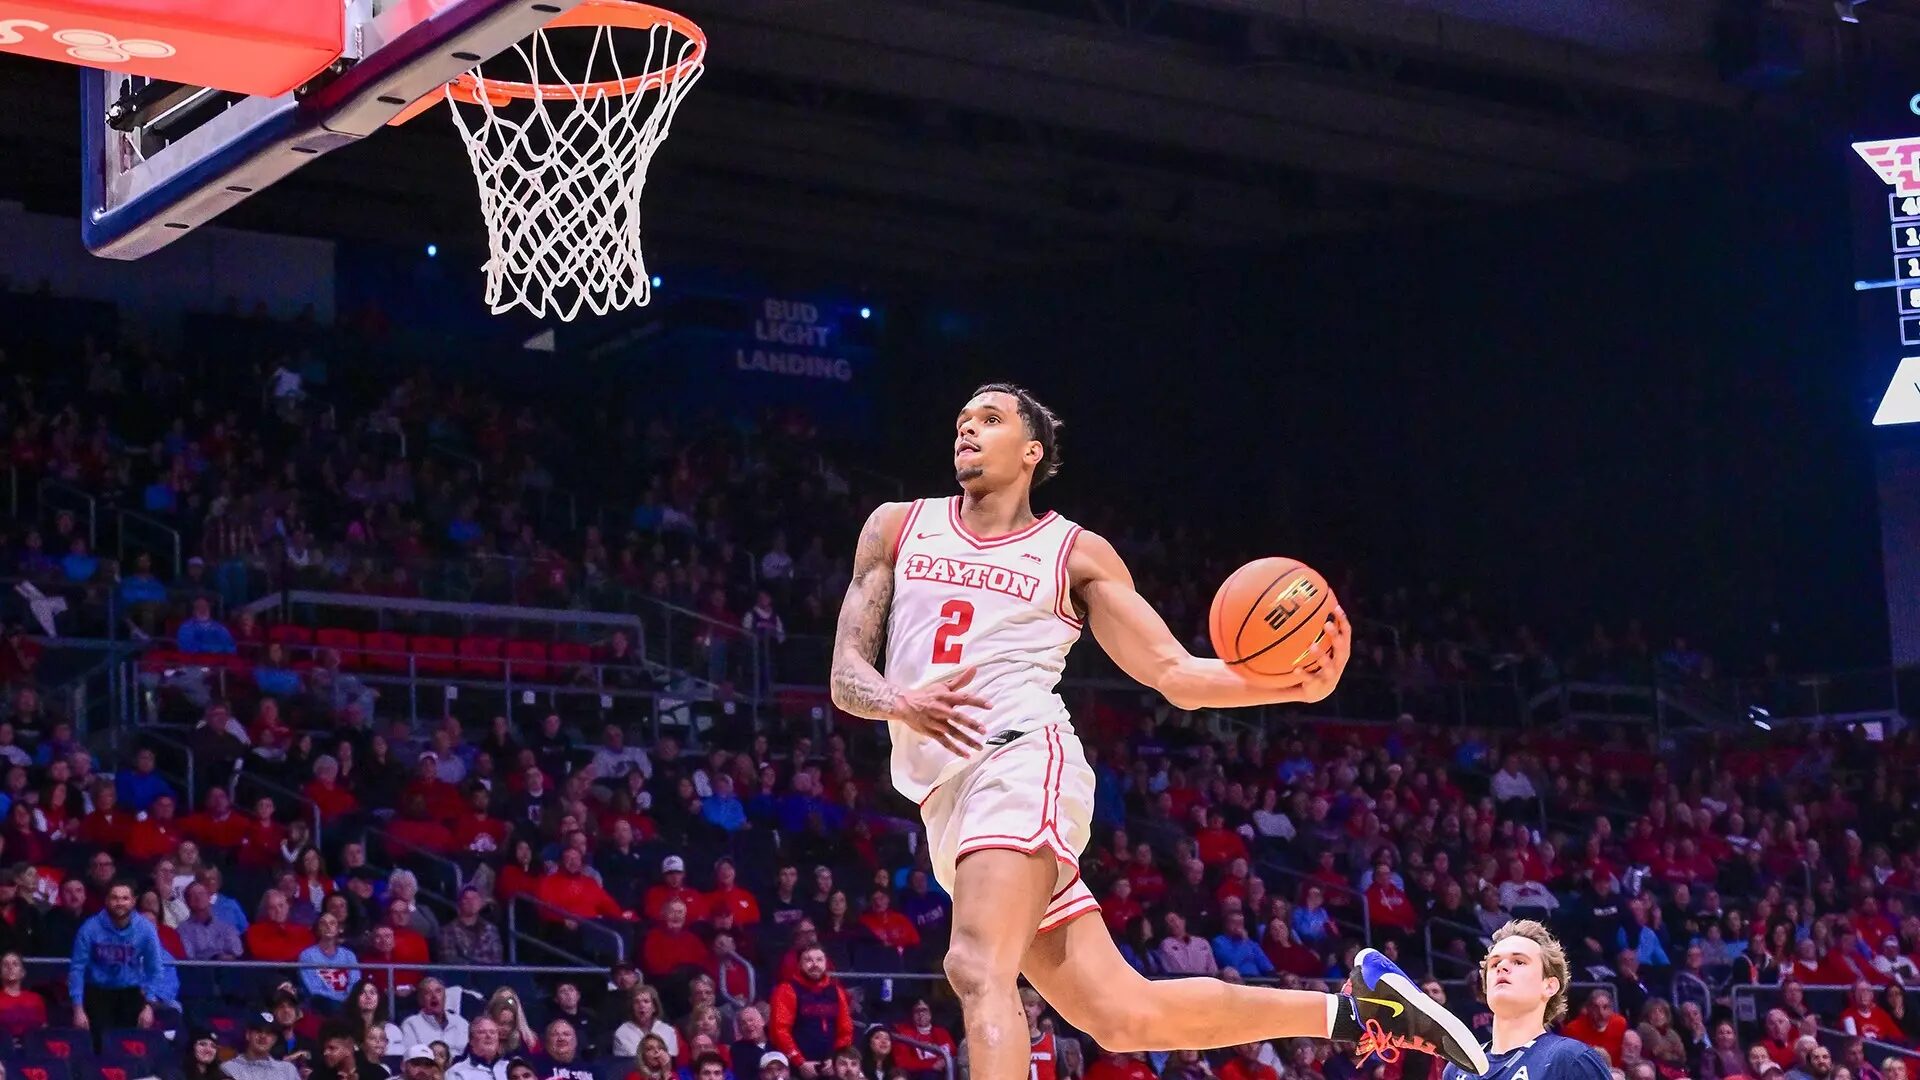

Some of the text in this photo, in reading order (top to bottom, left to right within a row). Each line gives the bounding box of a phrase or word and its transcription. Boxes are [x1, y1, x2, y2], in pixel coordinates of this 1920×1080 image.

[764, 298, 818, 324] BUD
[755, 319, 829, 347] LIGHT
[736, 348, 852, 382] LANDING
[905, 553, 1040, 602] DAYTON
[932, 599, 975, 664] 2
